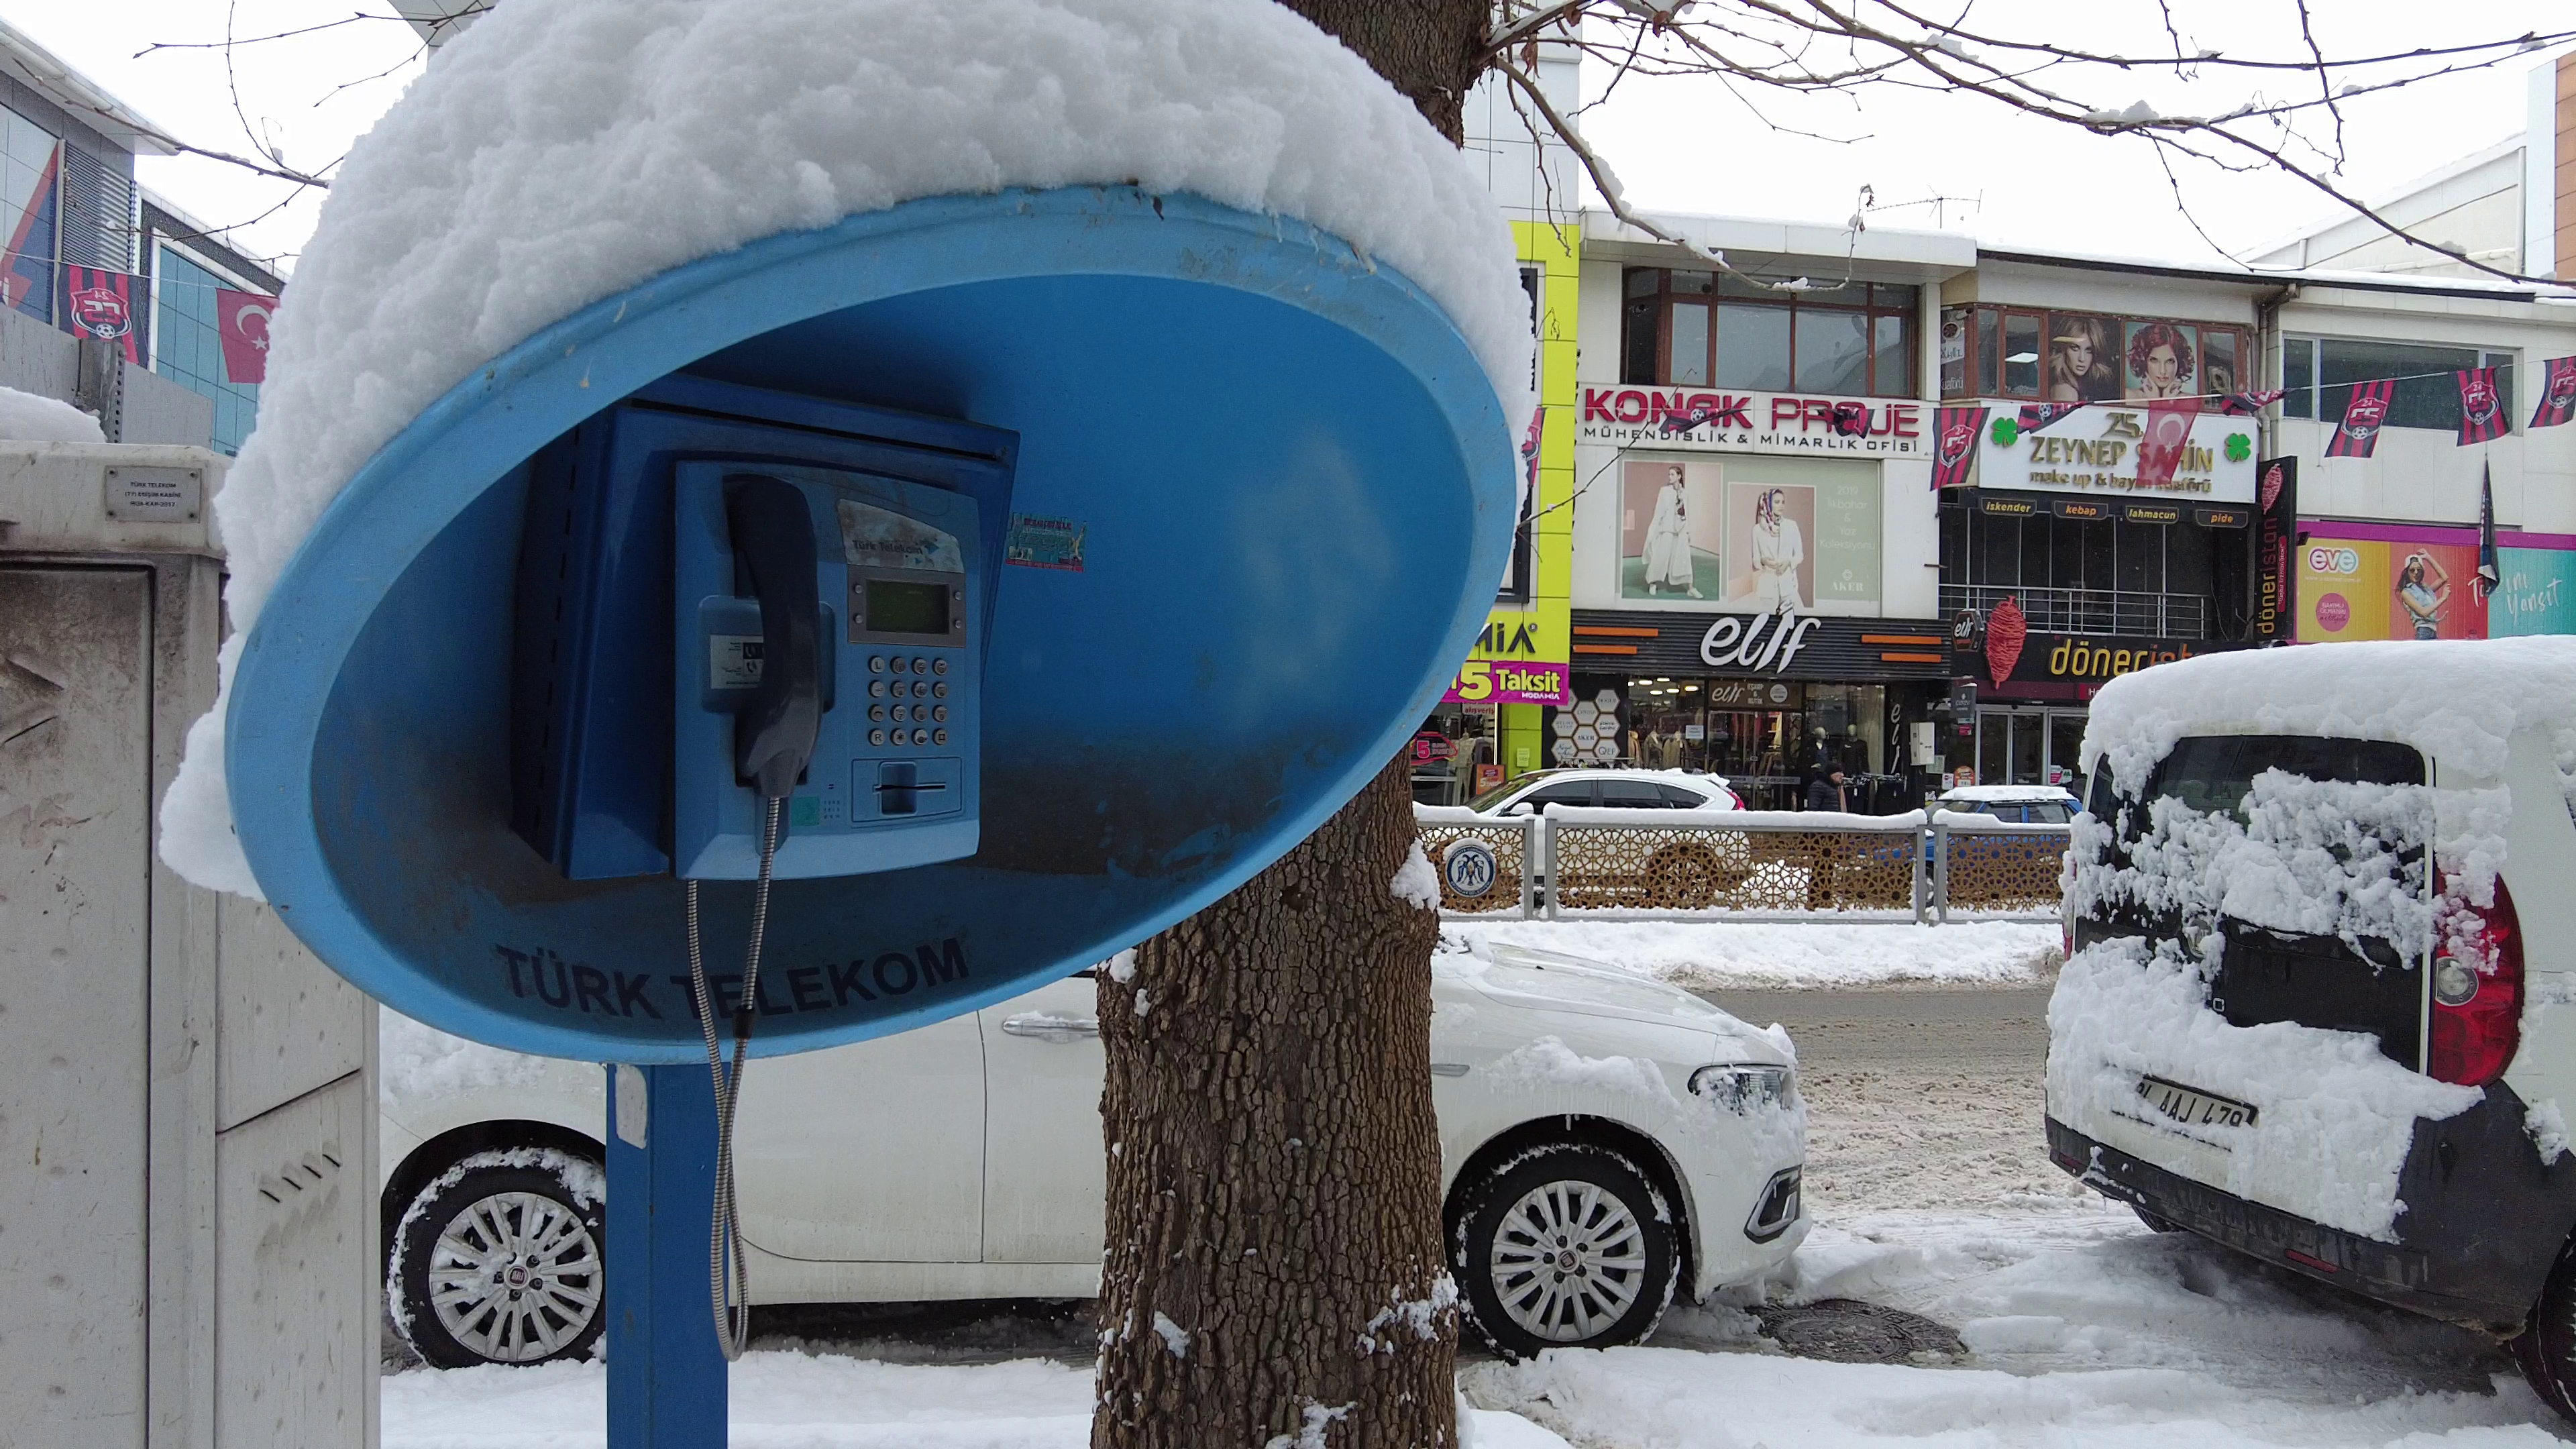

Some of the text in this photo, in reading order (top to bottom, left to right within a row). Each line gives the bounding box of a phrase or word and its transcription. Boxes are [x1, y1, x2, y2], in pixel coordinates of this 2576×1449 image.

[1585, 425, 1917, 452] MÜHENDİSLİK & MİMARLIK OFİSİ
[2030, 436, 2127, 466] ZEYNEP
[2029, 470, 2070, 484] make
[2072, 474, 2092, 489] up
[2094, 470, 2107, 485] &
[1837, 486, 1859, 495] 2019
[1986, 501, 2031, 513] iskender
[2065, 505, 2097, 517] kebap
[2129, 509, 2176, 520] lahmacun
[2210, 513, 2234, 523] pide
[1839, 526, 1857, 536] Yaz
[1819, 539, 1876, 551] Koleksiyonu
[2309, 547, 2359, 574] eve
[1830, 582, 1864, 592] AKER
[1495, 669, 1560, 692] Taksit
[1417, 740, 1430, 759] 5
[496, 936, 971, 1020] TÜRK TELEKOM
